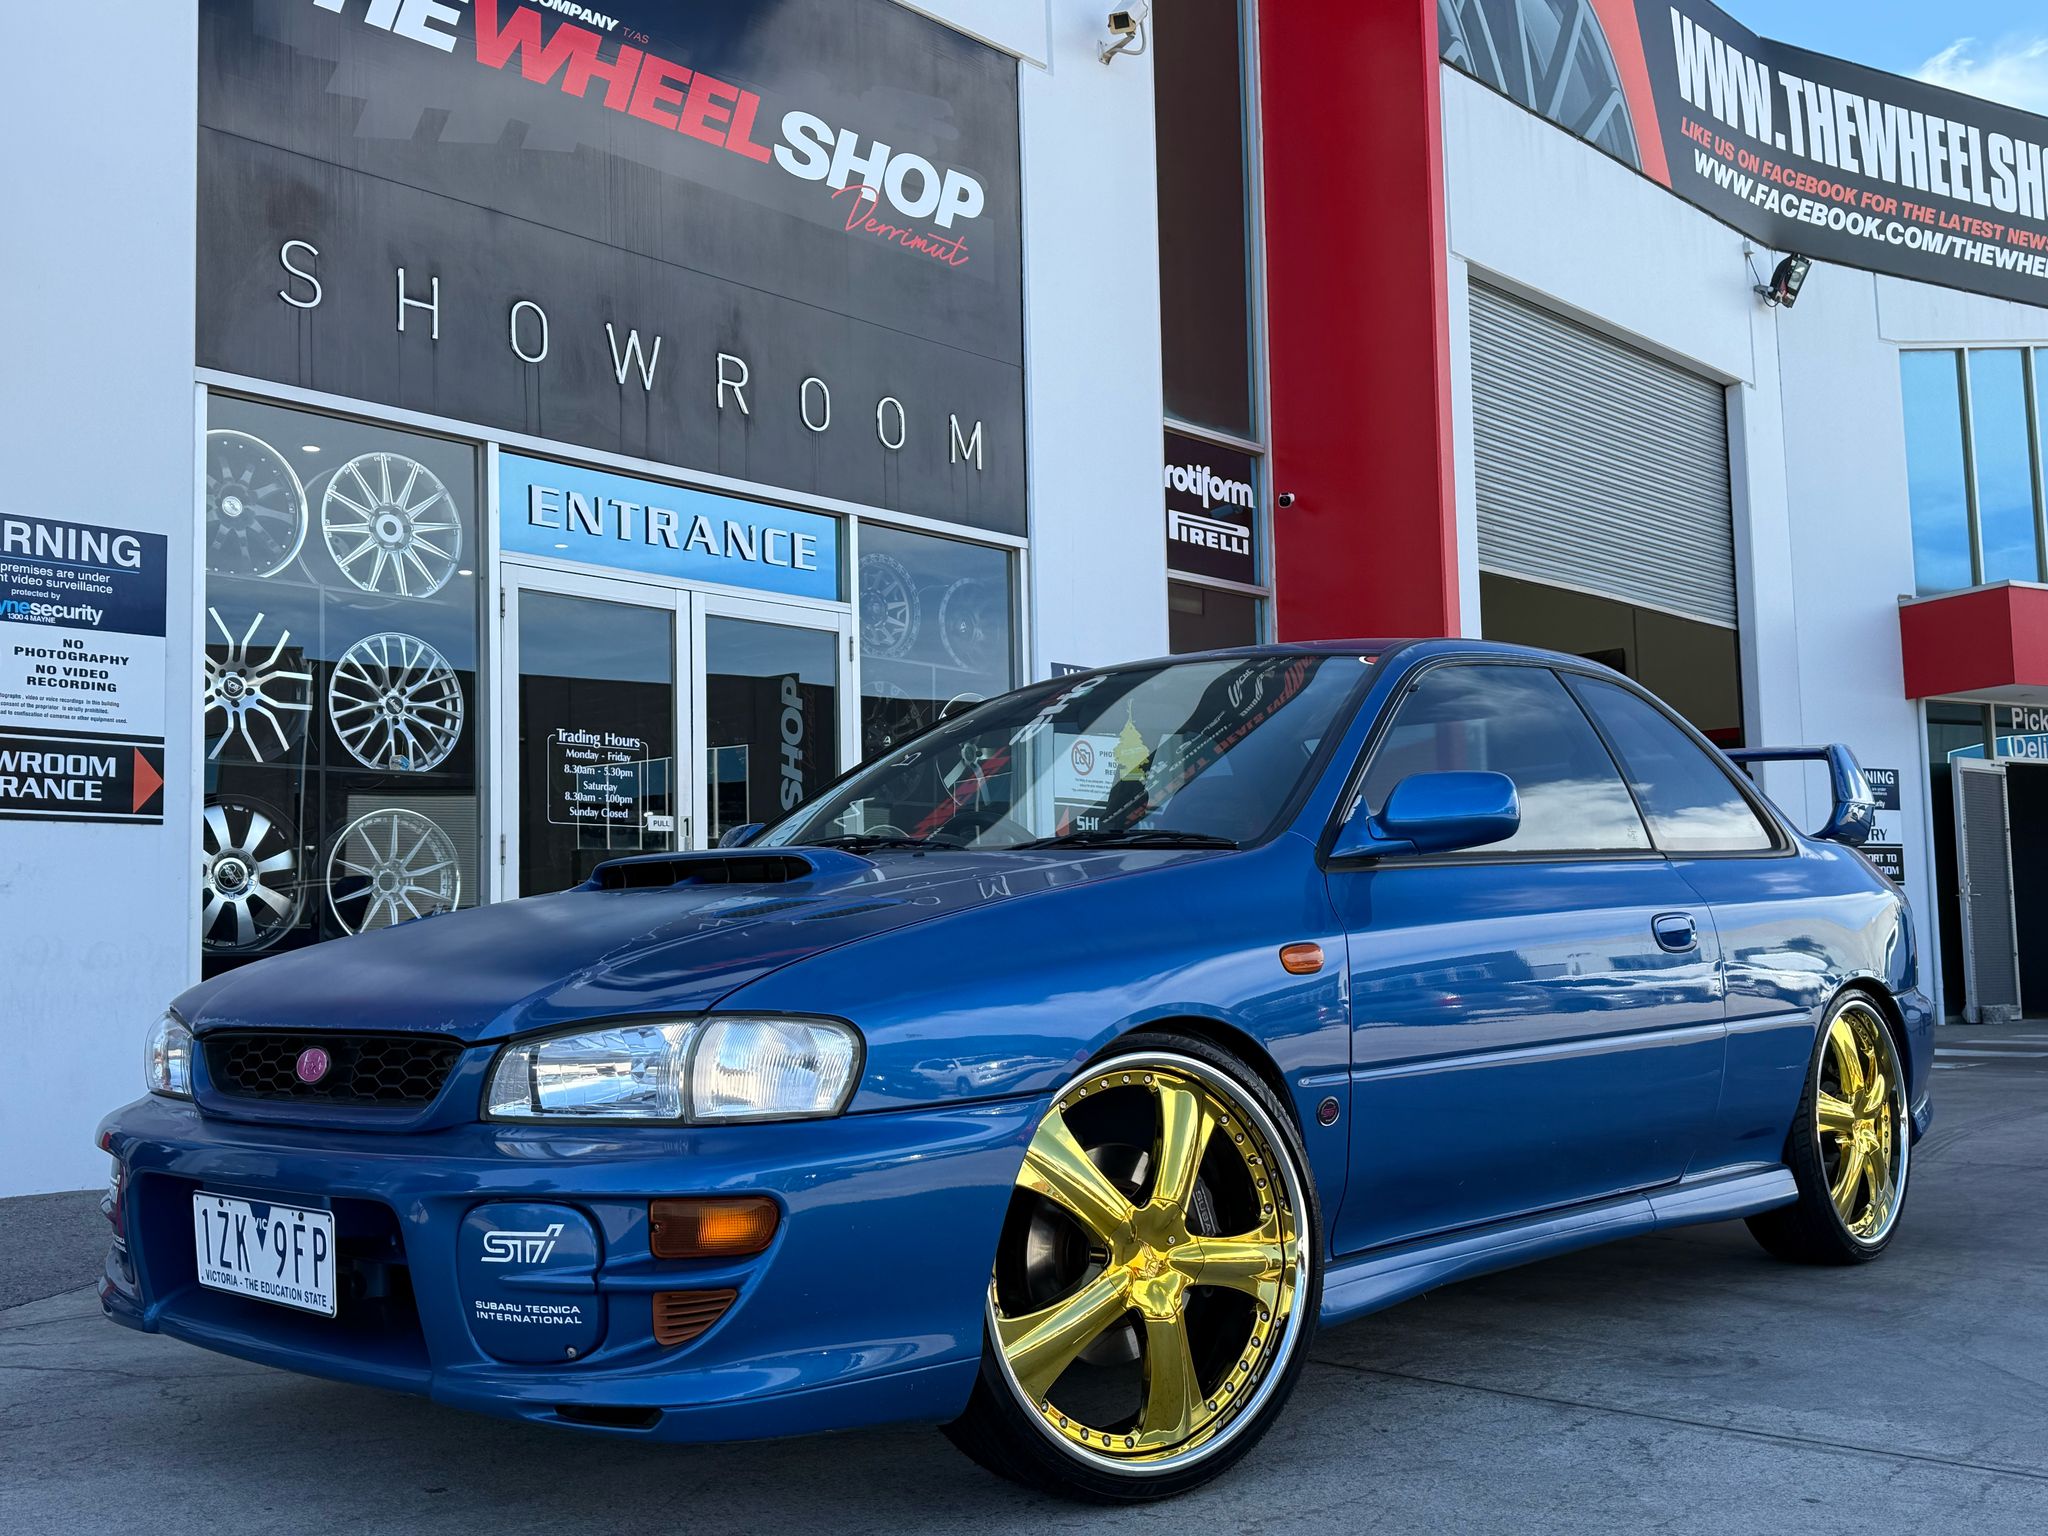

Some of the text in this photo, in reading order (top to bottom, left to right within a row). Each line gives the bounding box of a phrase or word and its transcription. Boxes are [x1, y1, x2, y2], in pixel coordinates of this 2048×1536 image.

[529, 0, 619, 31] OMPANY
[475, 0, 771, 164] WHEEL
[774, 111, 984, 228] SHOP
[1681, 116, 1712, 148] LIKE
[1715, 136, 1735, 161] US
[1737, 149, 1760, 174] ON
[1762, 160, 1858, 206] FACEBOOK
[1860, 192, 1898, 216] FOR
[1902, 202, 1936, 225] THE
[1939, 211, 2004, 241] LATEST
[279, 240, 983, 470] SHOWROOM
[1164, 464, 1256, 509] rotiform
[528, 484, 817, 572] ENTRANCE
[1168, 509, 1250, 555] PIRELLI
[3, 520, 141, 568] RNING
[1, 563, 111, 584] premises are under
[11, 574, 43, 587] video
[46, 578, 113, 595] surveillance
[11, 588, 61, 601] protected by
[7, 613, 24, 621] 1300
[30, 615, 56, 624] MAYNE
[63, 639, 84, 650] NO
[14, 646, 129, 666] PHOTOGRAPHY
[35, 664, 109, 680] NO VIDEO
[26, 676, 117, 693] RECORDING
[556, 728, 640, 749] Trading Hours
[780, 676, 803, 812] SHOP
[565, 749, 599, 762] Monday
[607, 751, 631, 764] Friday
[564, 764, 595, 775] 8.30am
[0, 776, 102, 801] RANCE
[564, 792, 595, 802] 8.30am
[583, 781, 618, 794] Saturday
[569, 806, 629, 819] Sunday Closed
[1868, 828, 1888, 841] RY
[1886, 853, 1897, 863] TO
[202, 1208, 328, 1288] 1ZK 9FP
[205, 1268, 238, 1287] VICTORIA
[244, 1277, 259, 1292] THE
[260, 1280, 302, 1302] EDUCATION
[304, 1291, 327, 1307] STATE
[475, 1300, 581, 1314] SUBARU TECNICA
[476, 1311, 583, 1324] INTERNATIONAL
